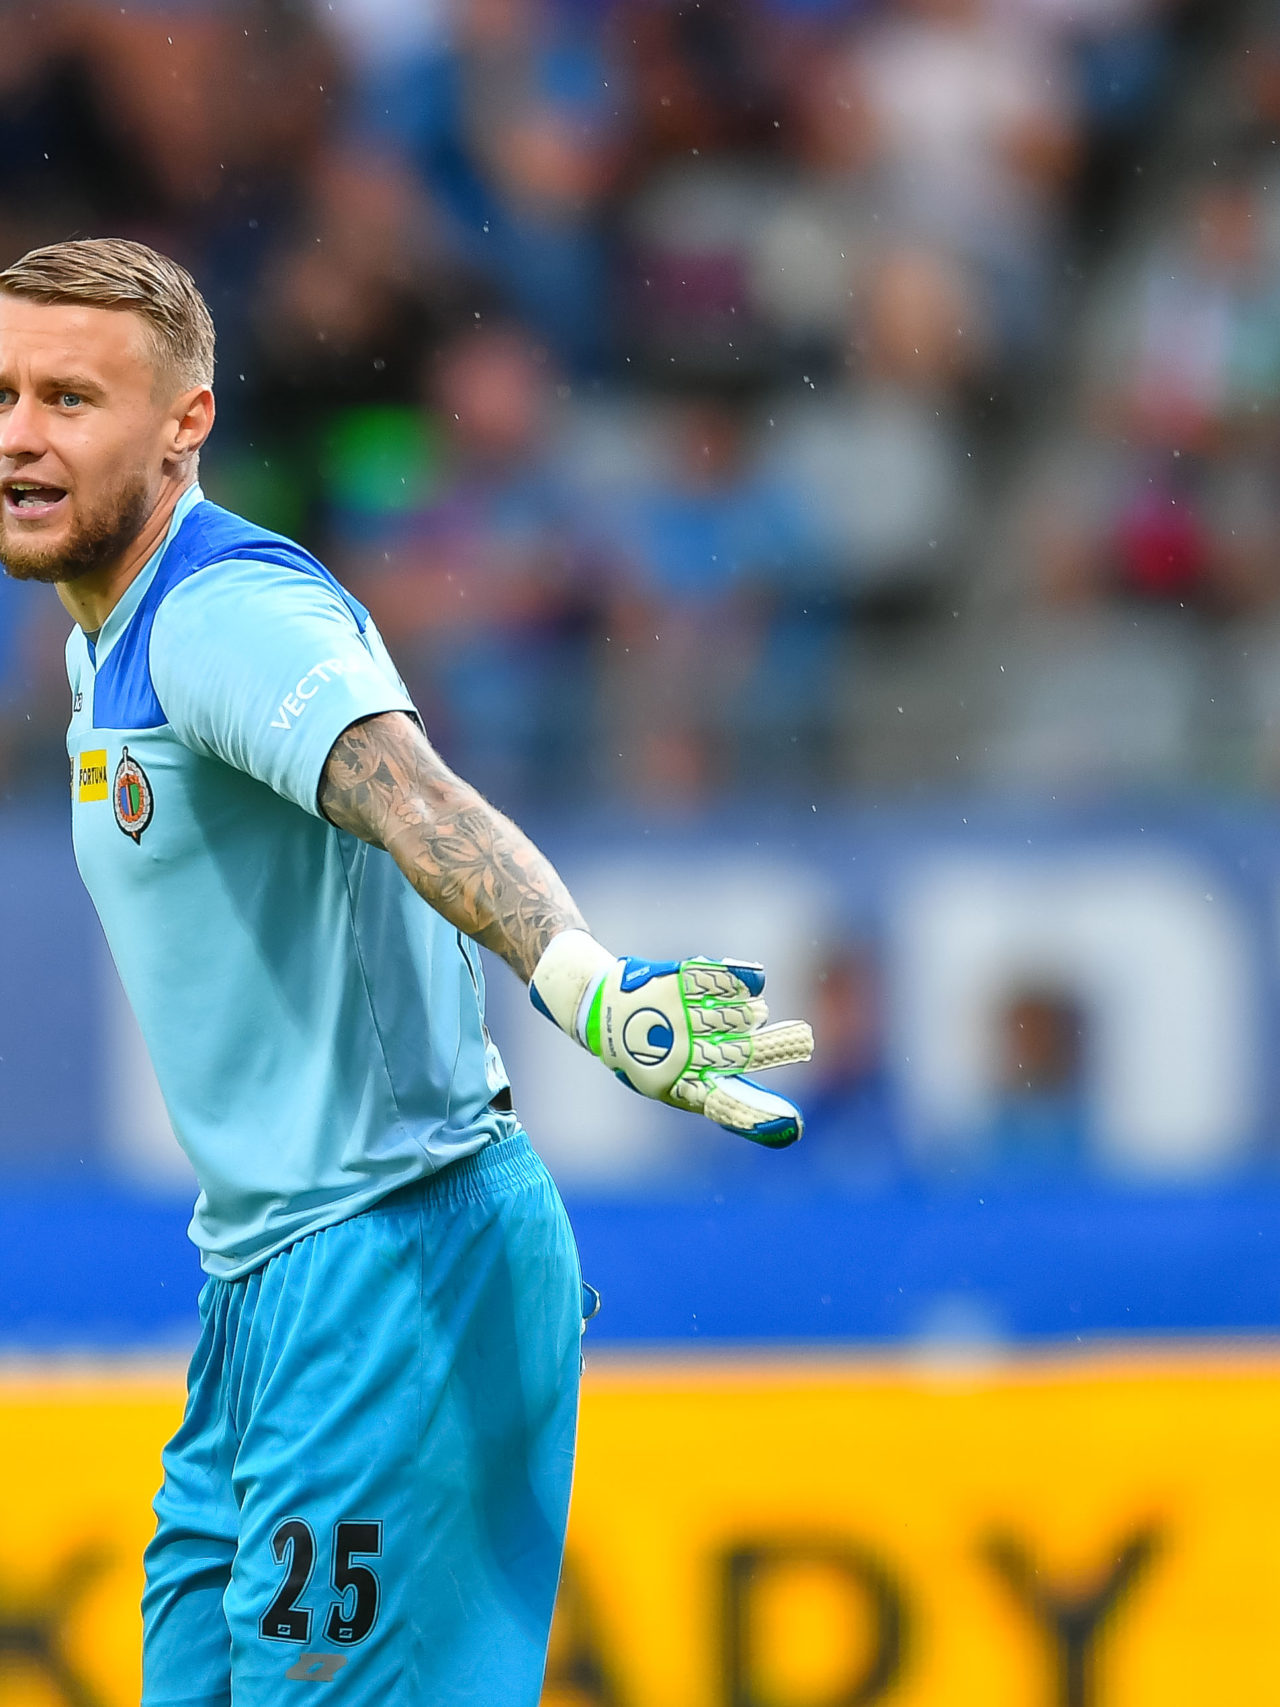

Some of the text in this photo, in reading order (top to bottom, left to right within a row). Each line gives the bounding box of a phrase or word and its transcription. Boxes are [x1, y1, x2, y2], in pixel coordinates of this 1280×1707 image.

[270, 658, 355, 730] VECTR
[79, 765, 108, 787] FORTUNA
[258, 1516, 383, 1647] 25
